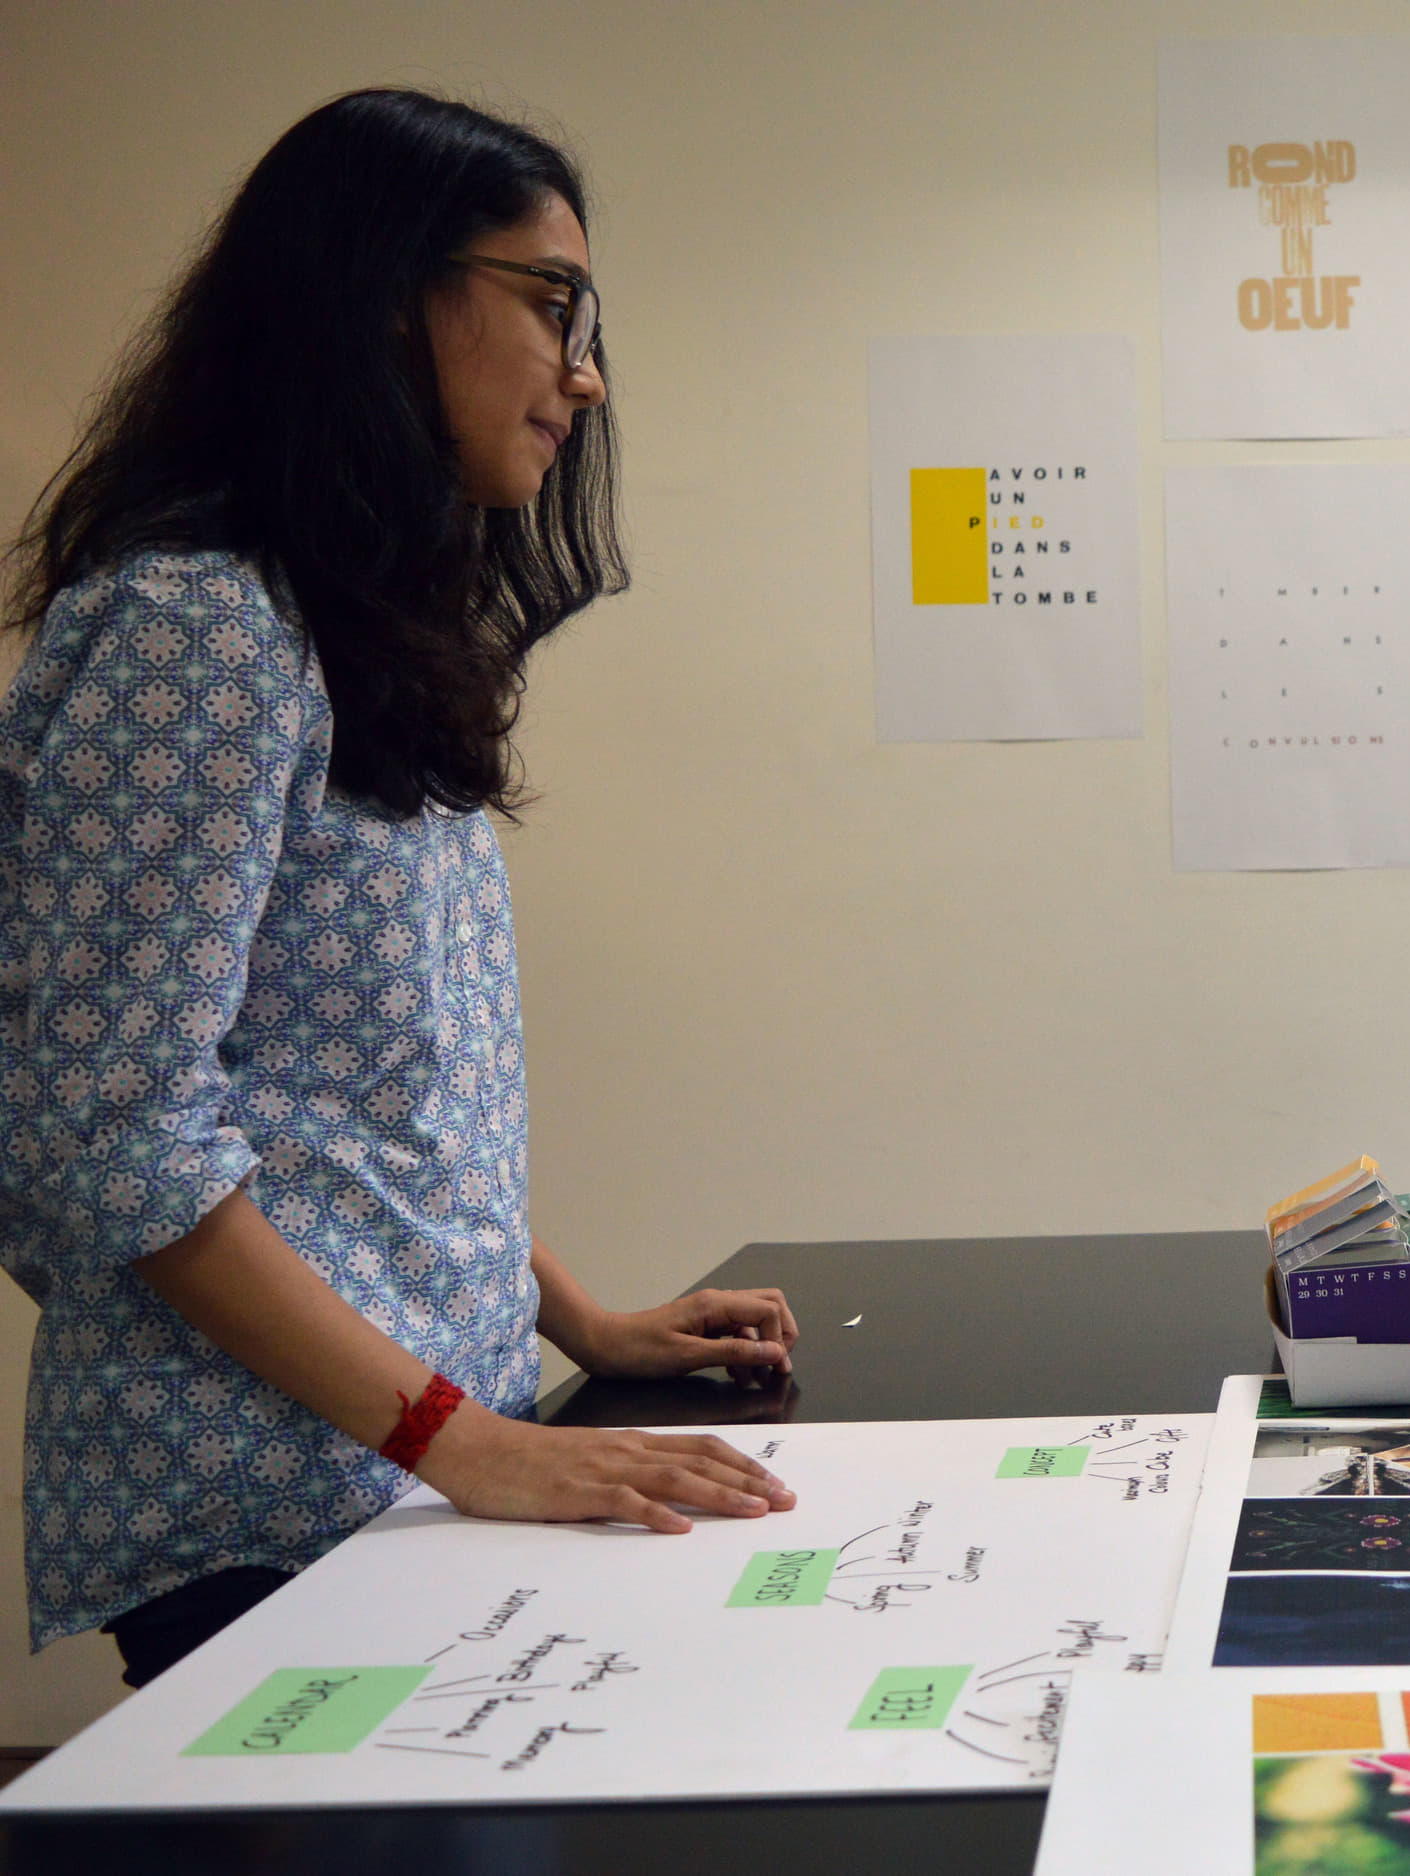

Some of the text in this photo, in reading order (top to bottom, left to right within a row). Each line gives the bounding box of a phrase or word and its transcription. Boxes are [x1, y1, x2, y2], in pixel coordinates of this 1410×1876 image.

[1228, 140, 1357, 188] ROND
[1257, 184, 1331, 226] COMME
[1281, 227, 1313, 276] UN
[1237, 275, 1361, 331] OEUF
[989, 466, 1087, 481] AVOIR
[990, 492, 1025, 505] UN
[969, 515, 1045, 530] PIED
[991, 541, 1071, 555] DANS
[991, 565, 1025, 579] LA
[992, 591, 1098, 606] TOMBE
[1298, 1269, 1407, 1287] M T W T F S S
[1298, 1288, 1344, 1299] 29 30 31
[1024, 1447, 1064, 1478] CONCEPT
[754, 1550, 817, 1602] SEASONS
[948, 1545, 987, 1584] Summer
[242, 1673, 359, 1750] CALENDAR
[870, 1683, 934, 1721] FEEL
